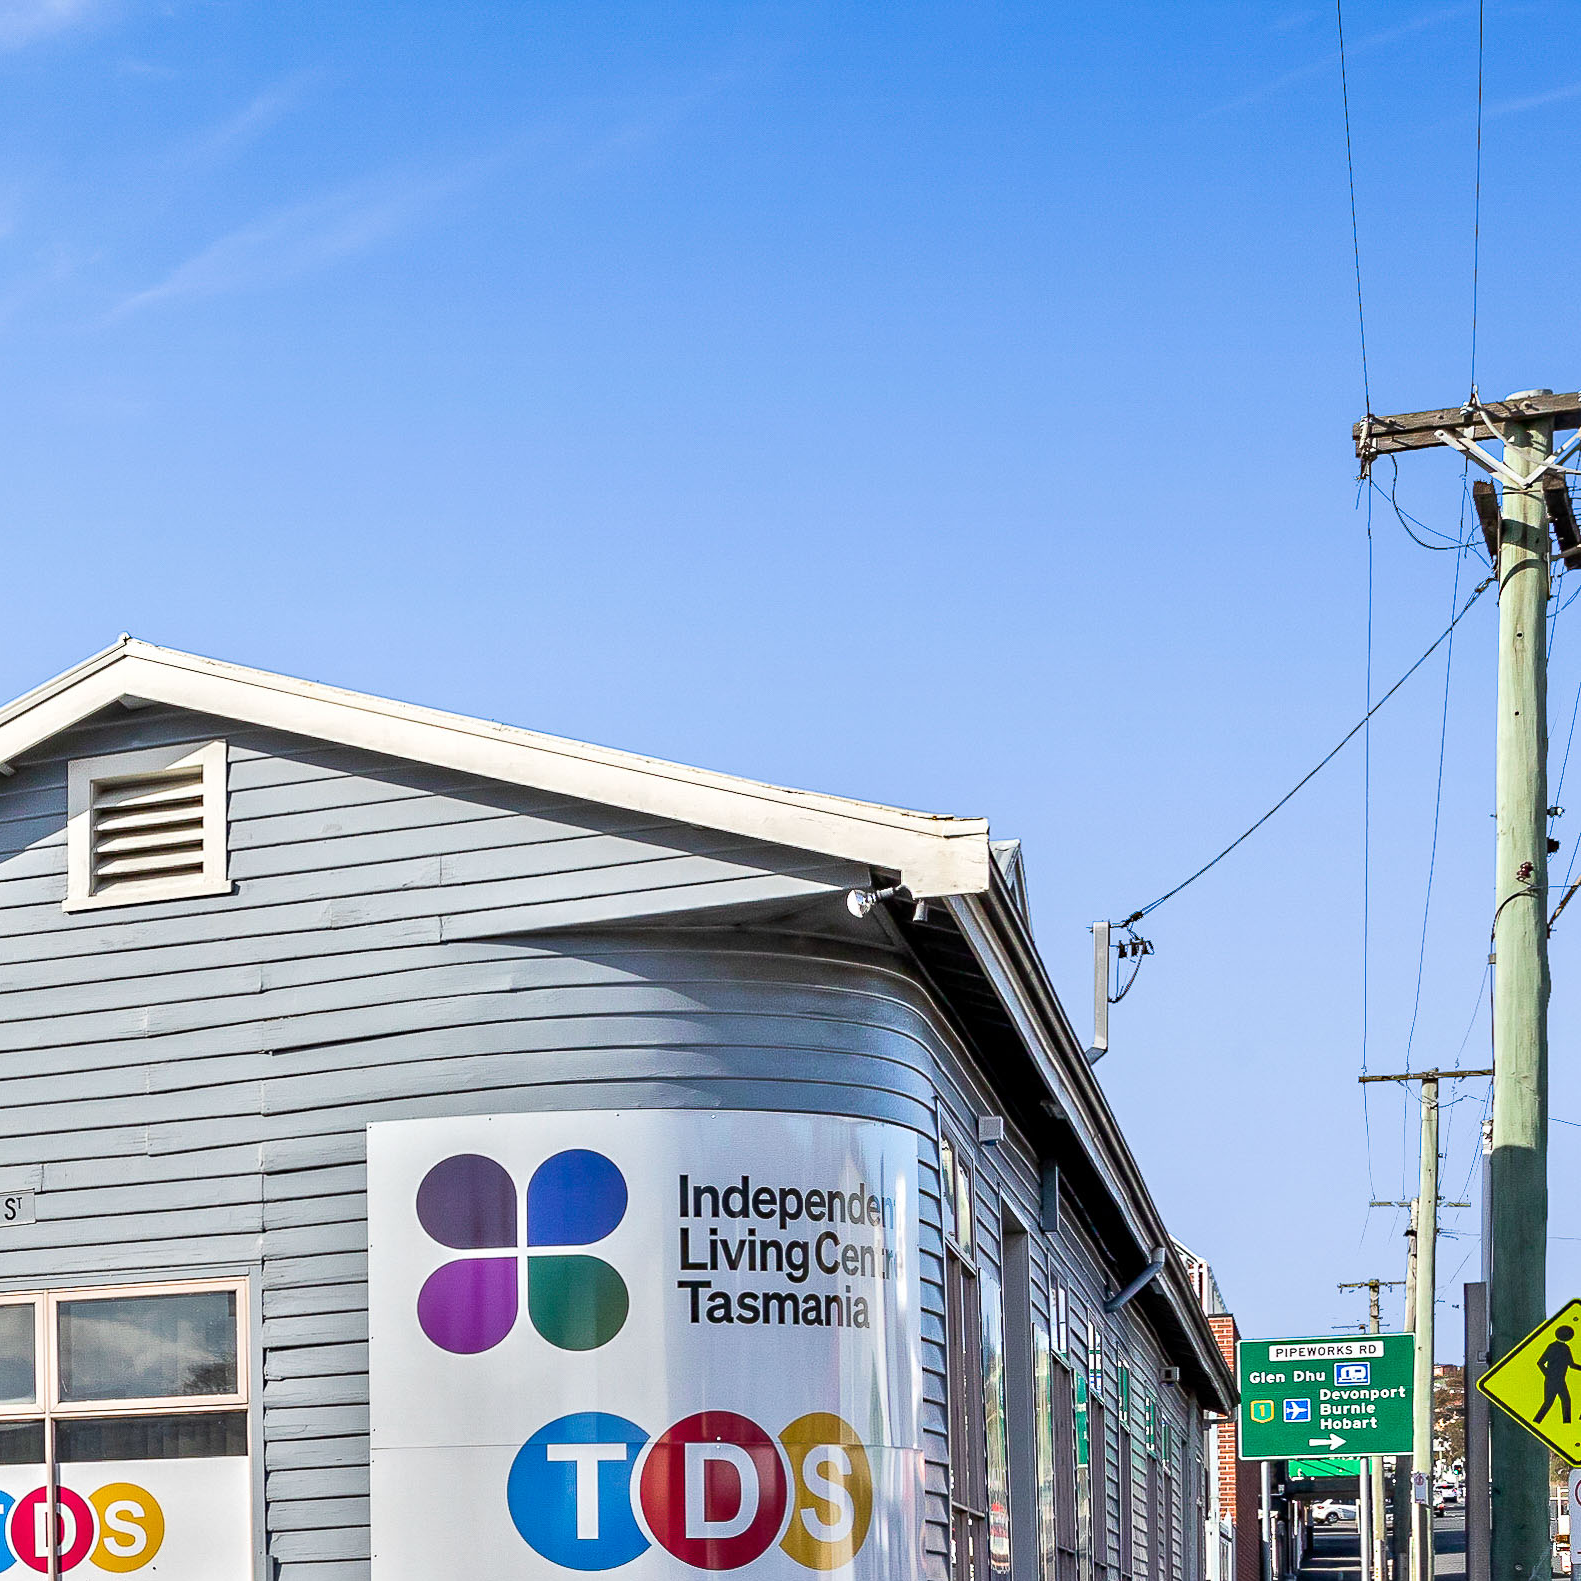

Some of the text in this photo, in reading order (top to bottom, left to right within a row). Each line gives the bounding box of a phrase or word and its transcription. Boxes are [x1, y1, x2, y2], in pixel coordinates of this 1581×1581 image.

[679, 1174, 897, 1230] Independen
[680, 1227, 809, 1284] Living
[677, 1280, 870, 1329] Tasmania
[1276, 1345, 1376, 1357] PIPEWORKS RD
[1250, 1370, 1325, 1383] Glen Dhu
[1320, 1386, 1406, 1401] Devonport
[1259, 1405, 1265, 1417] 1
[1320, 1403, 1375, 1415] Burnie
[1320, 1417, 1377, 1430] Hobart
[547, 1443, 853, 1544] TDS
